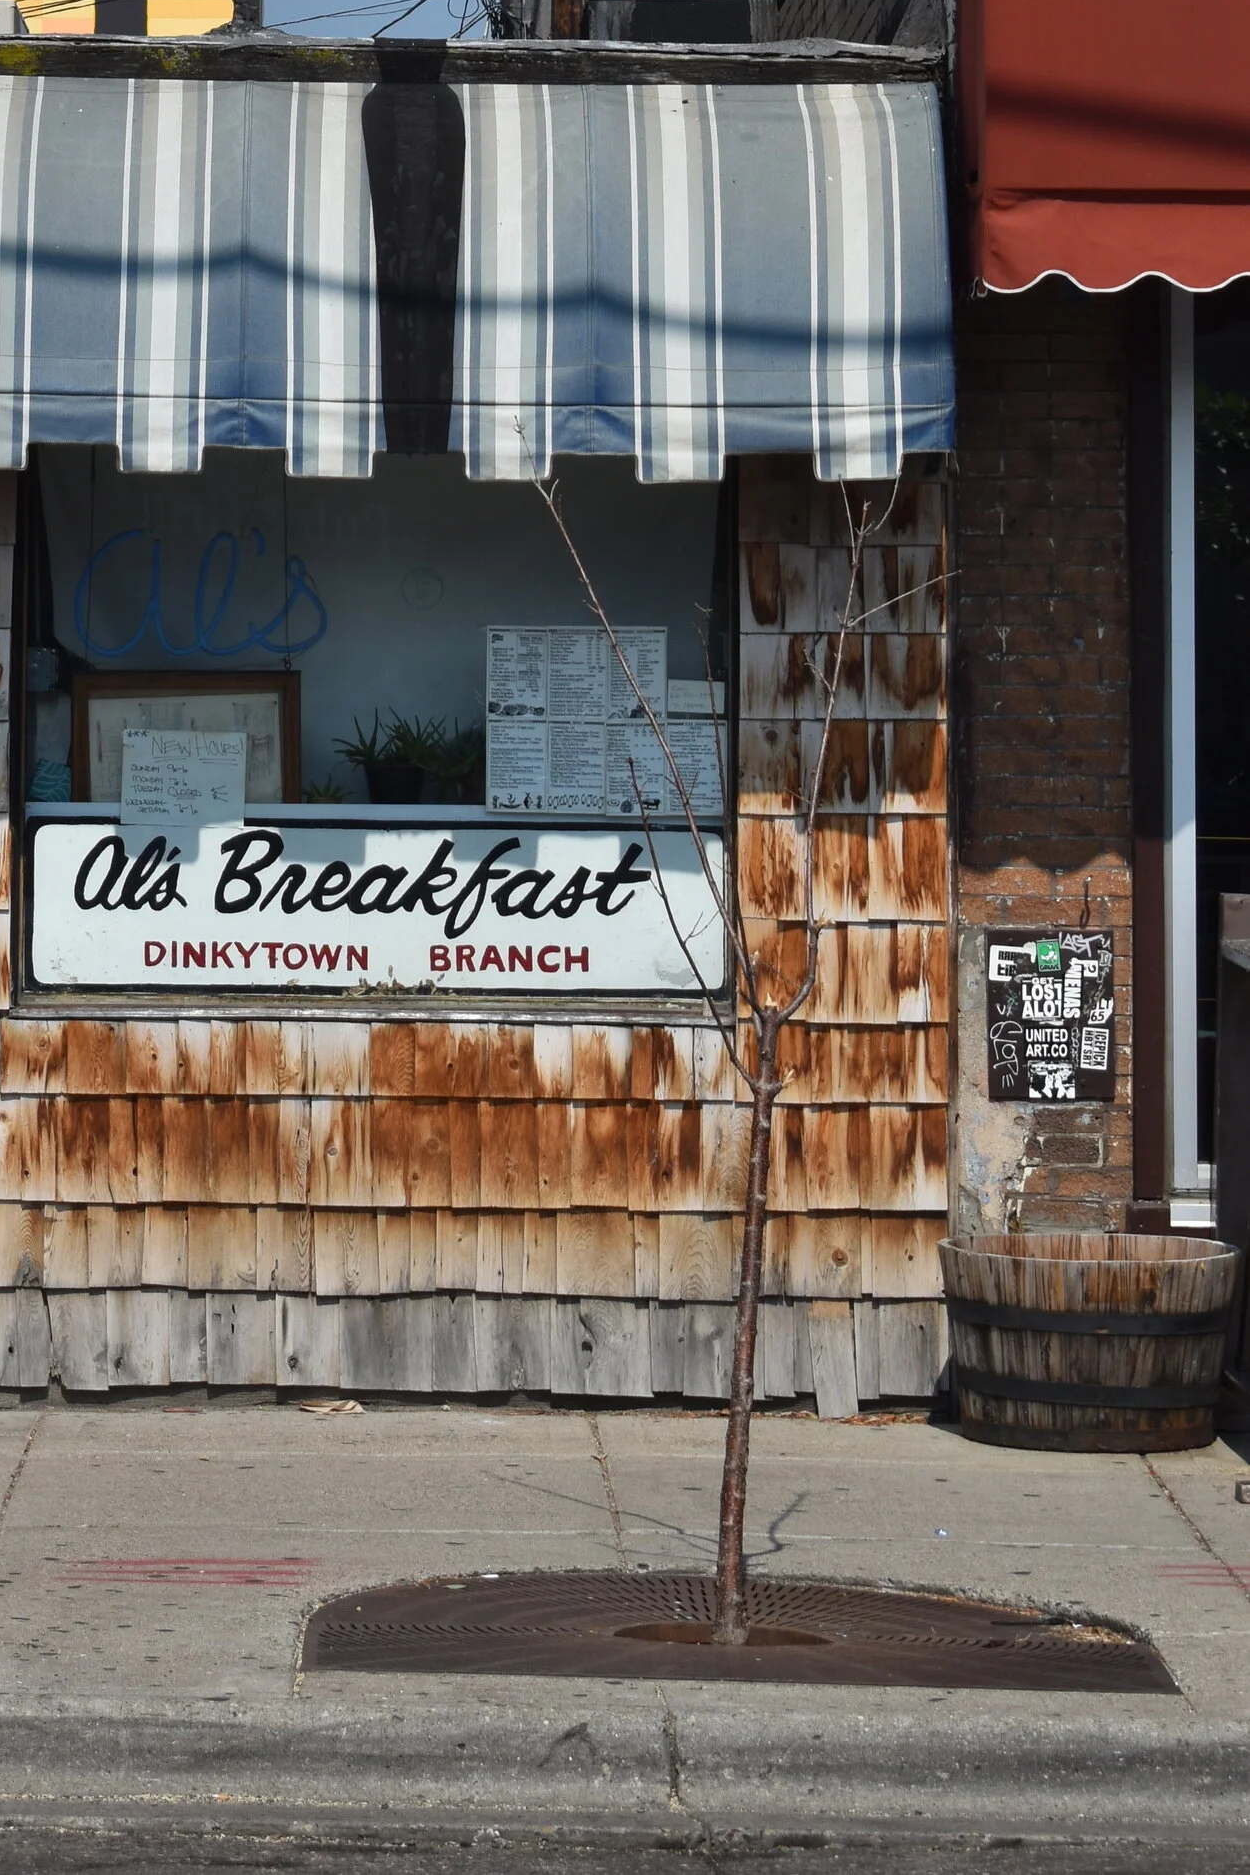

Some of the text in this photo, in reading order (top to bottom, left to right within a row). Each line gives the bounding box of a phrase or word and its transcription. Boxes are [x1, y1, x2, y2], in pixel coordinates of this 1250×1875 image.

[151, 735, 191, 757] NEW
[73, 829, 650, 939] Al's Breakfast
[143, 940, 590, 974] DINKYTOWN BRANCH
[1031, 976, 1054, 985] GET
[1090, 1011, 1105, 1022] 65
[1025, 1028, 1068, 1042] UNITED
[1025, 1043, 1068, 1057] ART.CO
[1093, 1031, 1107, 1067] ICEPICK
